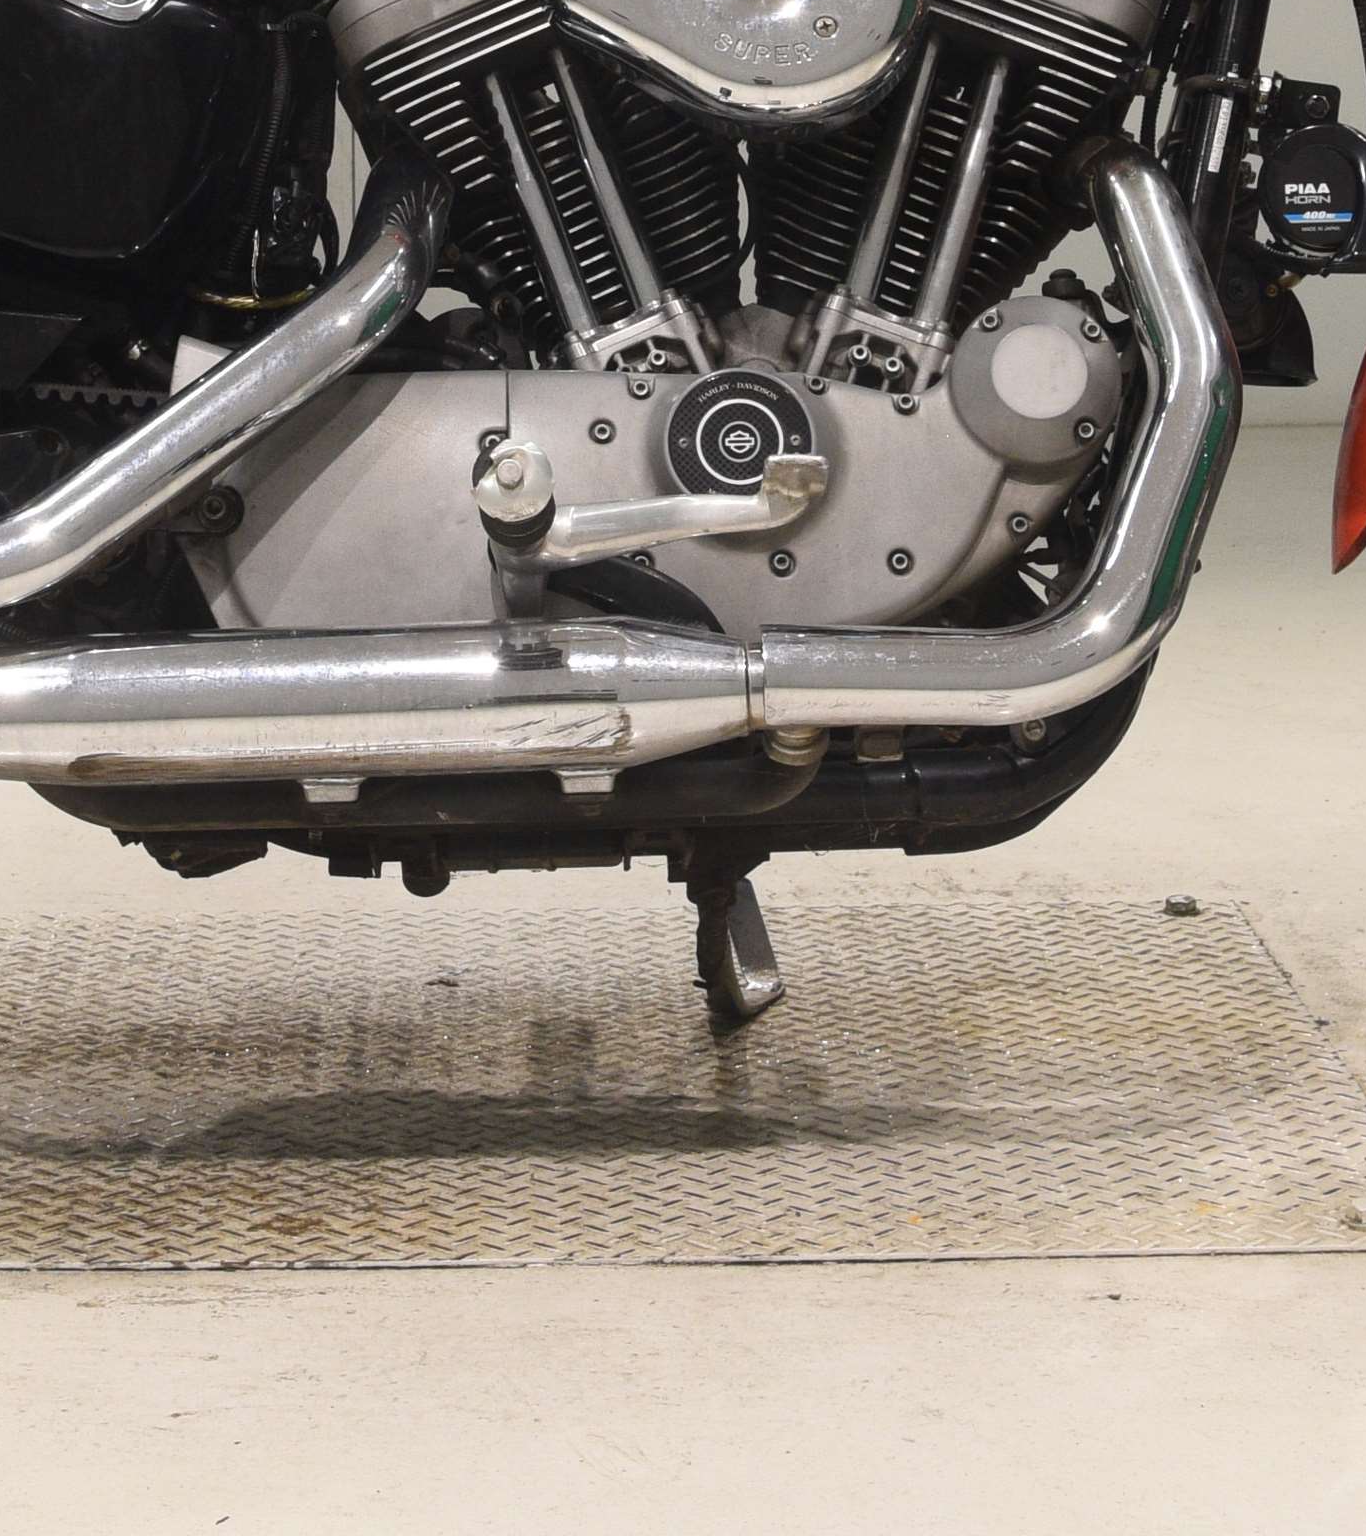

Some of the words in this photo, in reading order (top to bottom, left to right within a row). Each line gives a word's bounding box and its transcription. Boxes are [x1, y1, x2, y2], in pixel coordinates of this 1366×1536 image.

[714, 32, 819, 66] SUPER
[1284, 182, 1331, 195] PIAA
[1285, 195, 1331, 204] HORN
